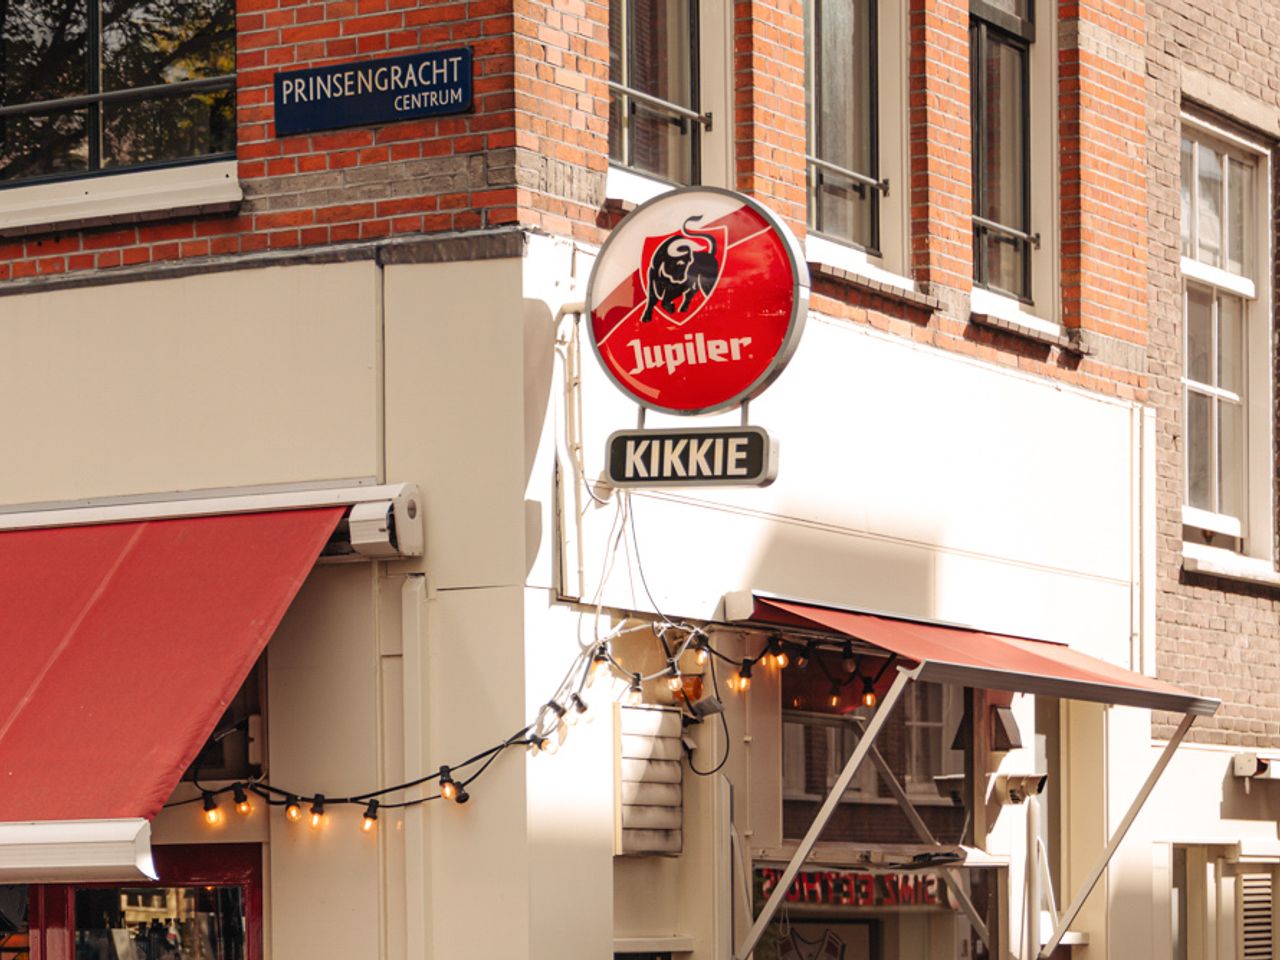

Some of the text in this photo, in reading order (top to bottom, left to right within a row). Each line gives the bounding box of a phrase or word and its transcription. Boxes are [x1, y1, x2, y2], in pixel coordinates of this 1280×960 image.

[282, 56, 463, 105] PRINSENGRACHT
[394, 87, 463, 112] CENTRUM
[626, 332, 752, 376] Jupiler
[624, 437, 749, 478] KIKKIE
